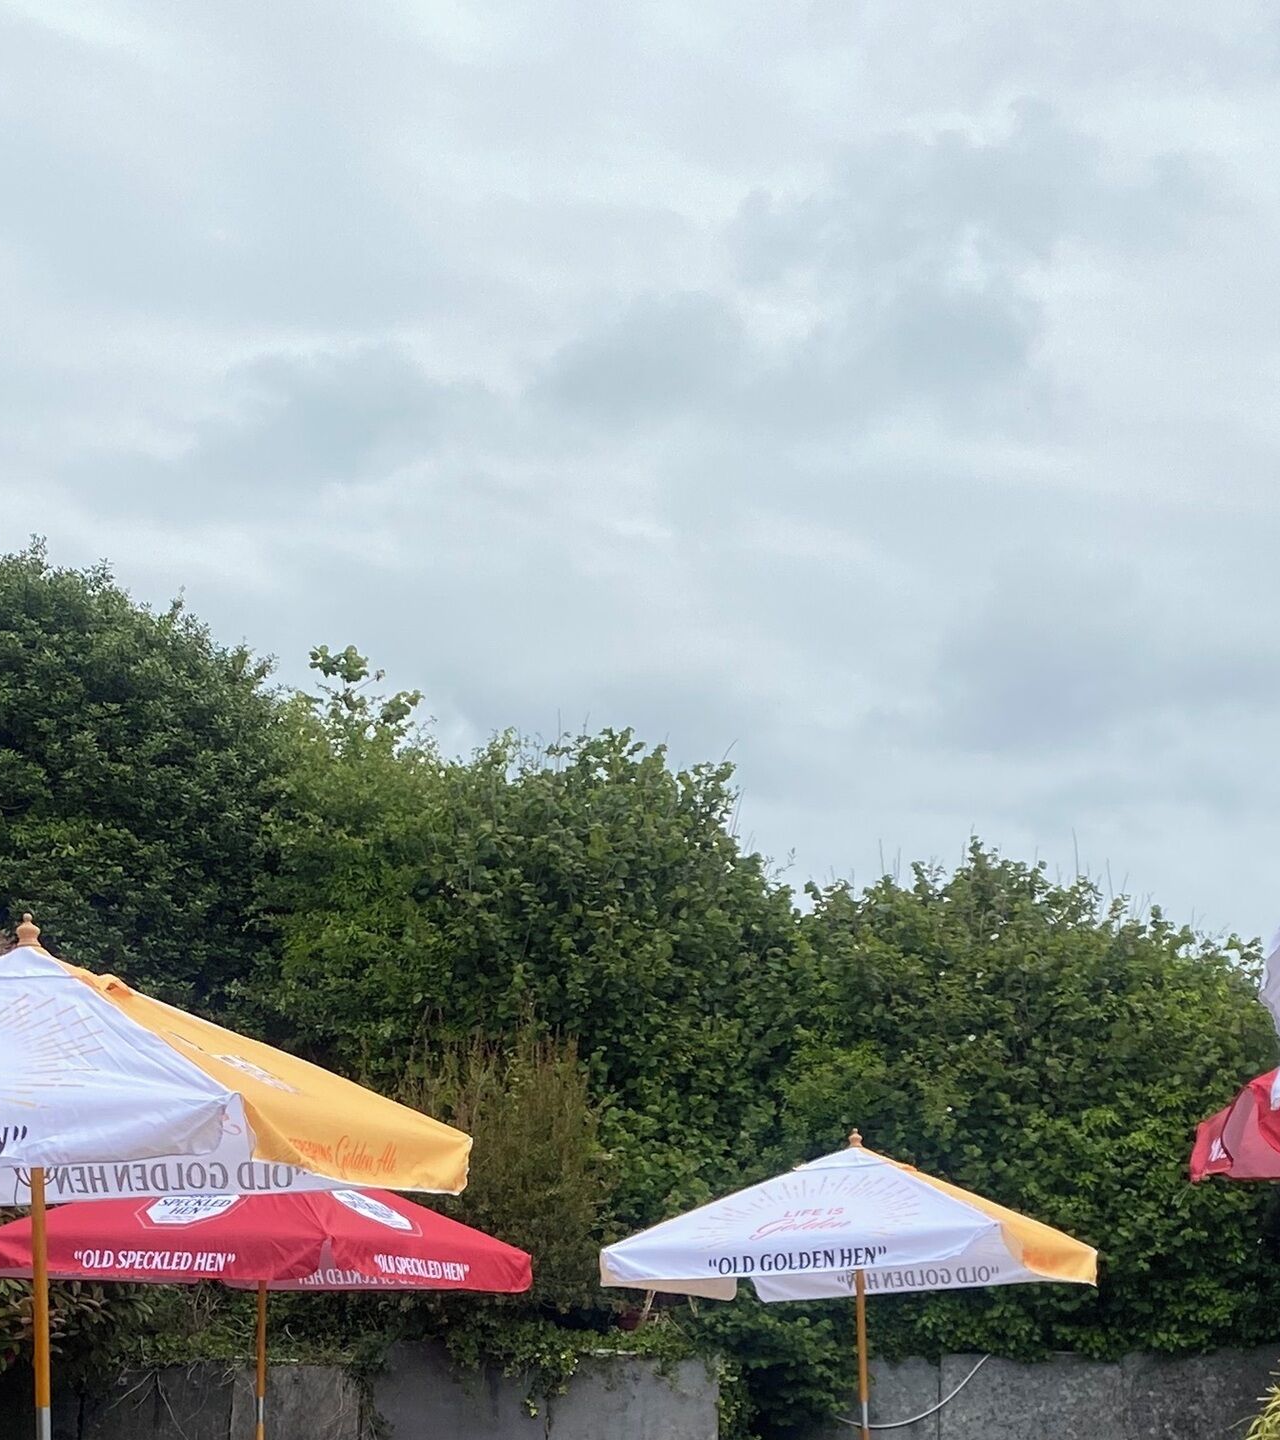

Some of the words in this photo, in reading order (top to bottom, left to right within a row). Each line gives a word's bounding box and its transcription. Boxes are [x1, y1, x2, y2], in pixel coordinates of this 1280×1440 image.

[784, 1208, 823, 1217] LIFE
[74, 1250, 114, 1268] “OLD
[115, 1250, 192, 1271] SPECKLED
[194, 1252, 236, 1272] HEN”
[395, 1256, 441, 1280] SPECKLED
[708, 1255, 755, 1275] “OLD
[760, 1249, 836, 1272] GOLDEN
[840, 1245, 887, 1267] HEN”
